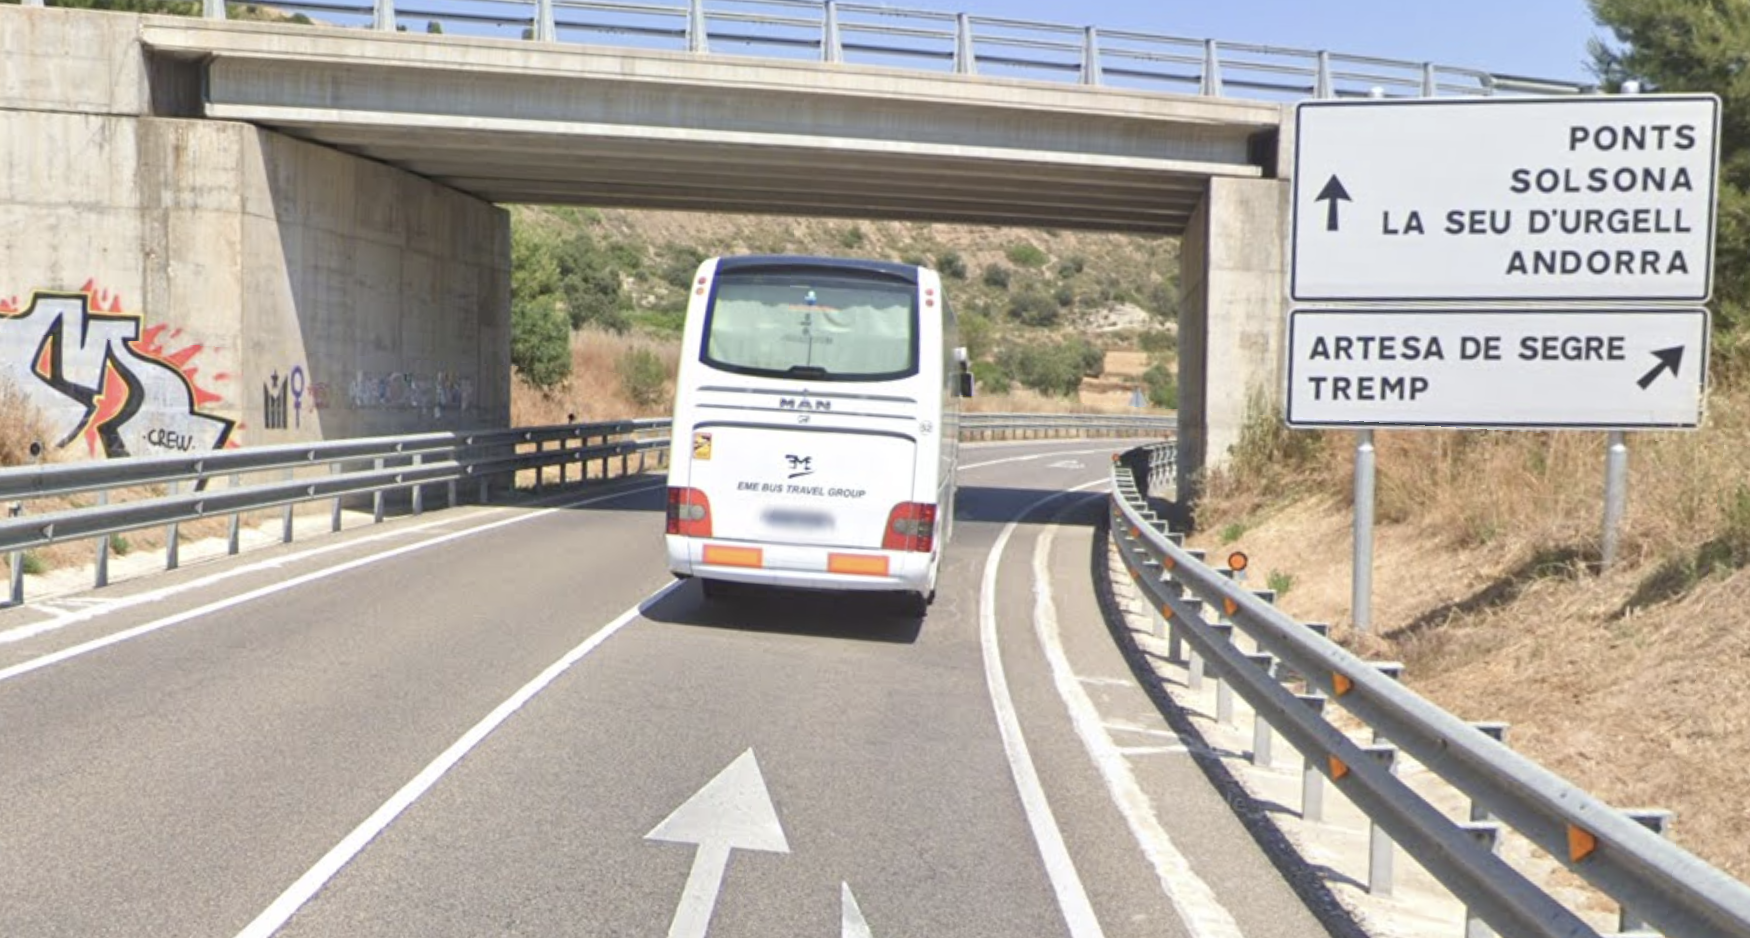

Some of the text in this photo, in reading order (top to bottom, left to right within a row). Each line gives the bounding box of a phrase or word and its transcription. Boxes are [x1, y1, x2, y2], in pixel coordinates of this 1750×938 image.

[1569, 124, 1696, 151] PONTS
[1509, 166, 1693, 193] SOLSONA
[1382, 208, 1692, 235] LA SEU D'URGELL
[1505, 249, 1689, 275] ANDORRA
[1309, 335, 1626, 361] ARTESA DE SEGRE
[1308, 376, 1429, 401] TREMP
[779, 397, 831, 410] MAN
[737, 481, 866, 499] EME BUS TRAVEL GROUP
